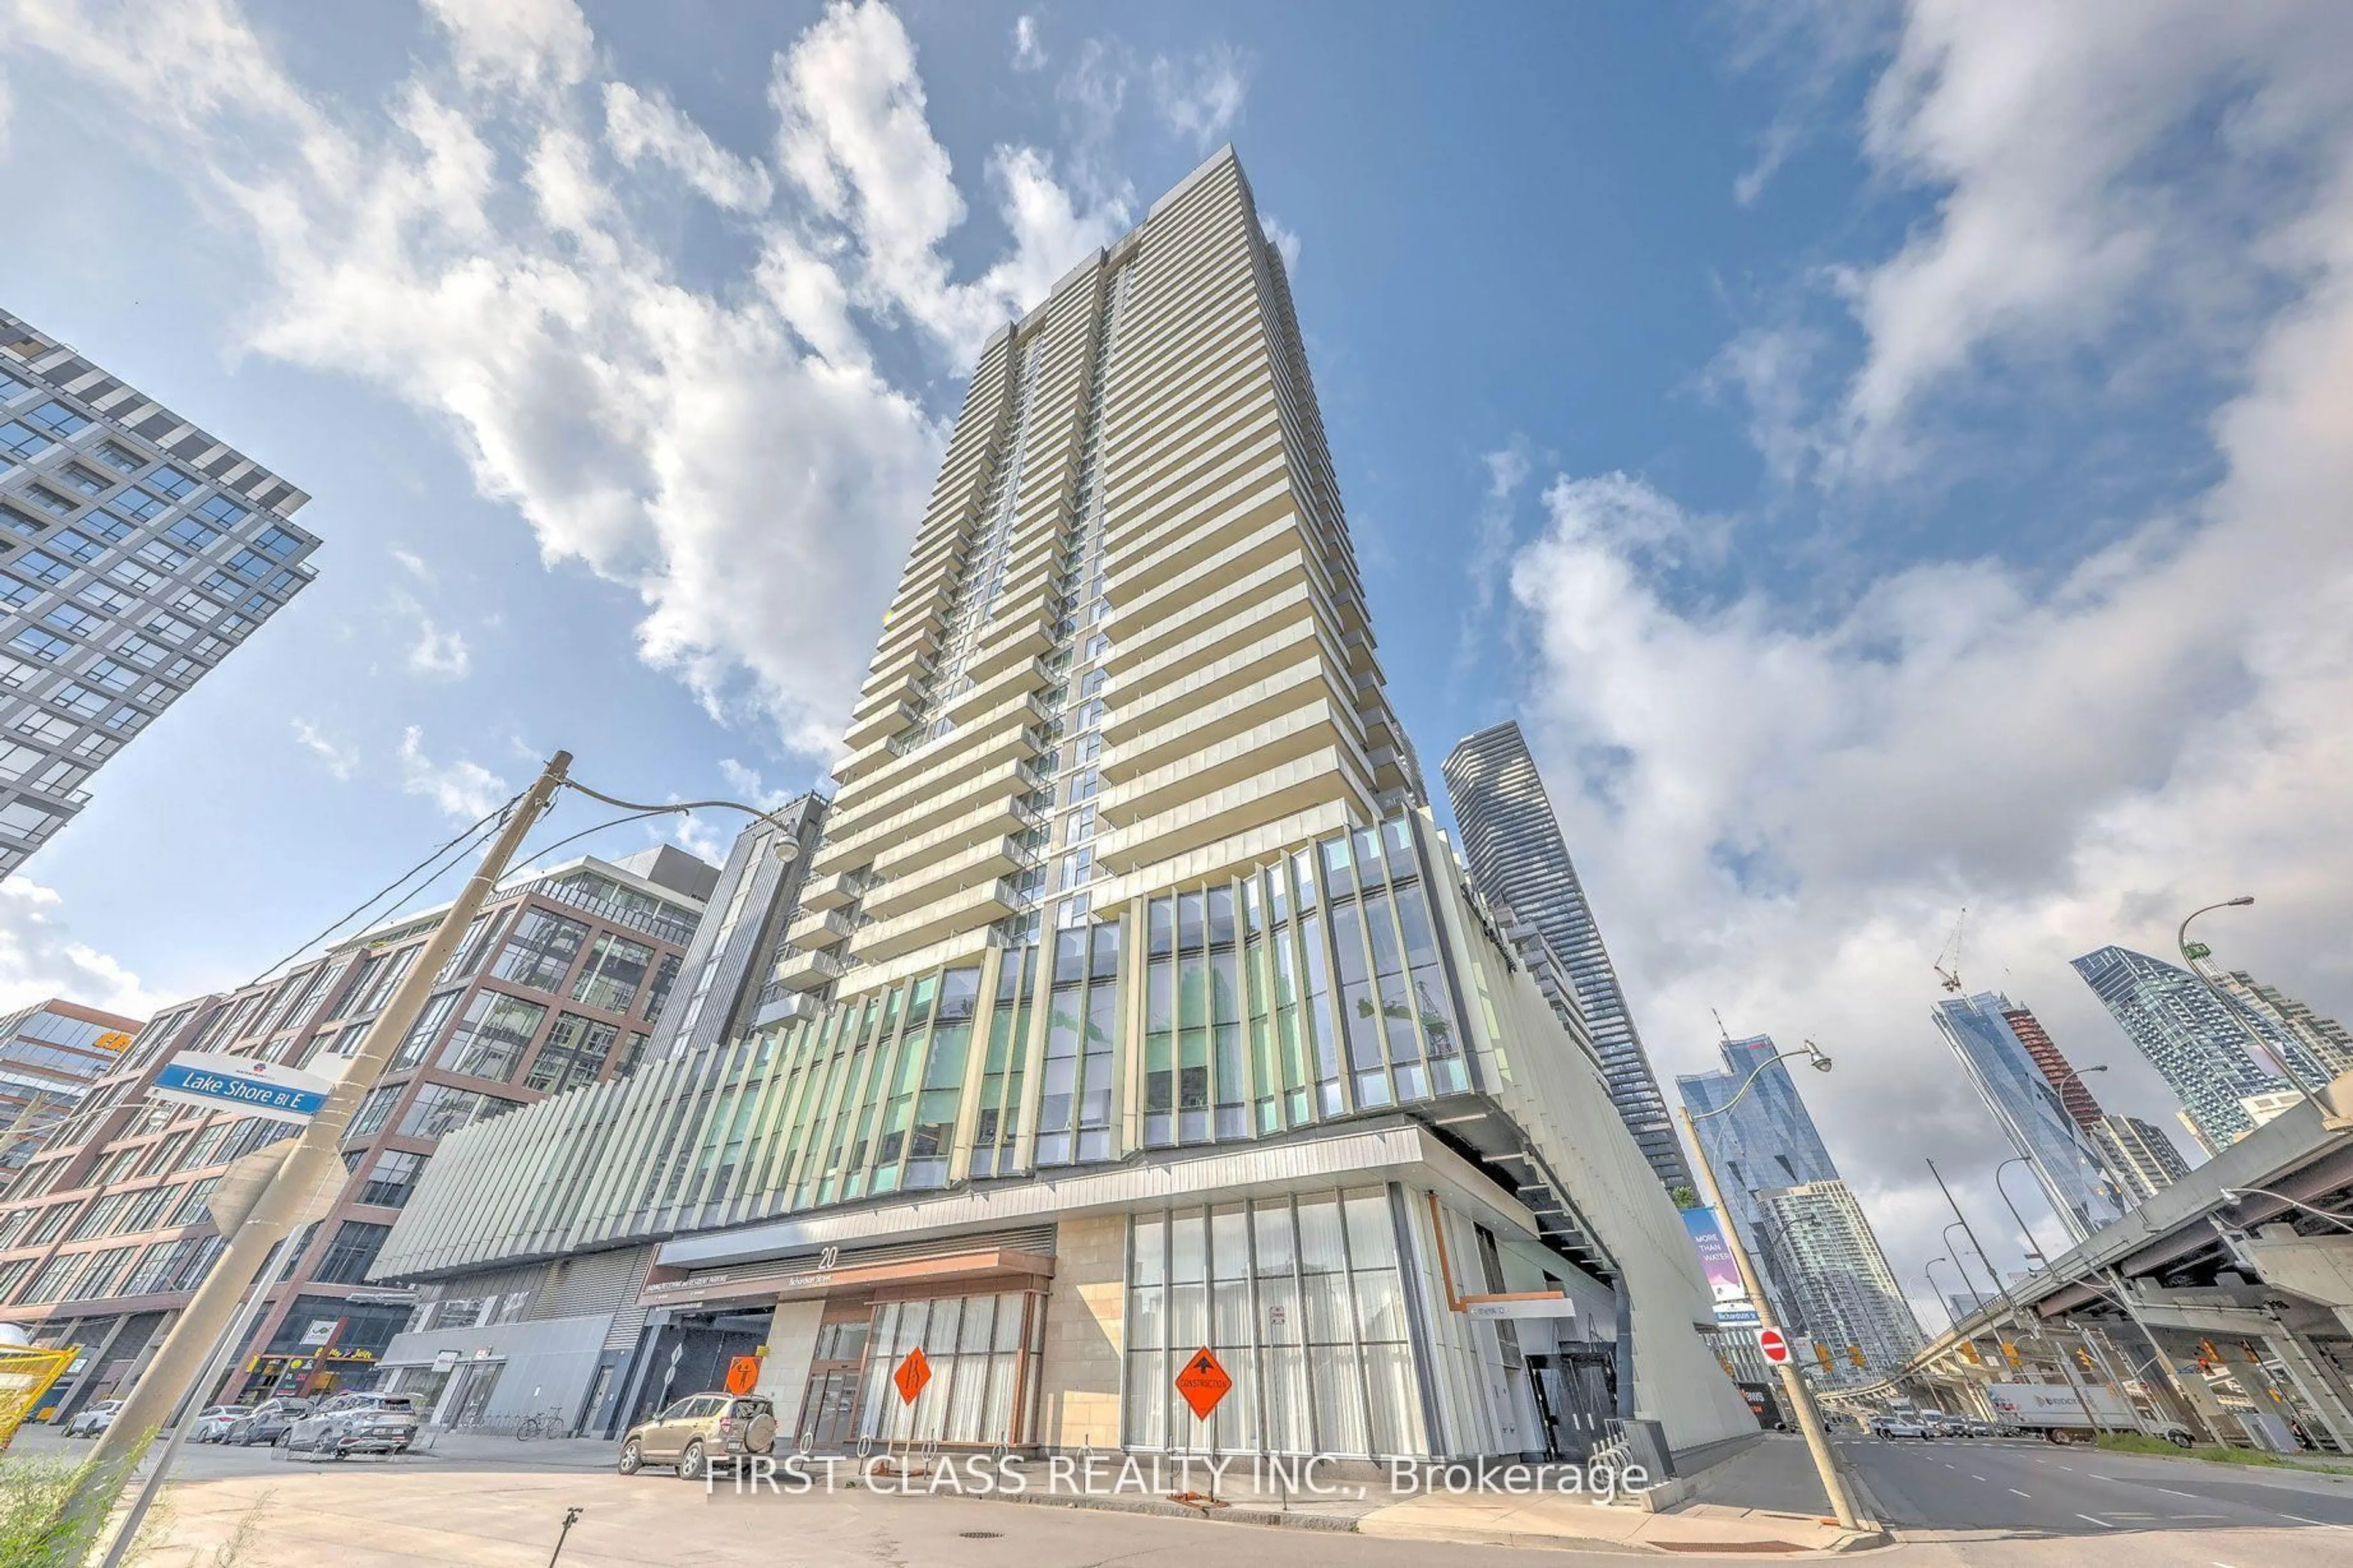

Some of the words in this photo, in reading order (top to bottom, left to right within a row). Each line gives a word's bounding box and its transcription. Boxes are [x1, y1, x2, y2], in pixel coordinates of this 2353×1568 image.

[182, 1071, 223, 1092] Lake
[224, 1080, 273, 1102] Shore
[274, 1093, 289, 1107] Bl
[290, 1093, 305, 1108] E
[1694, 1233, 1718, 1243] MORE
[818, 1246, 838, 1269] 20
[1180, 1379, 1227, 1388] CONSTRUCTION
